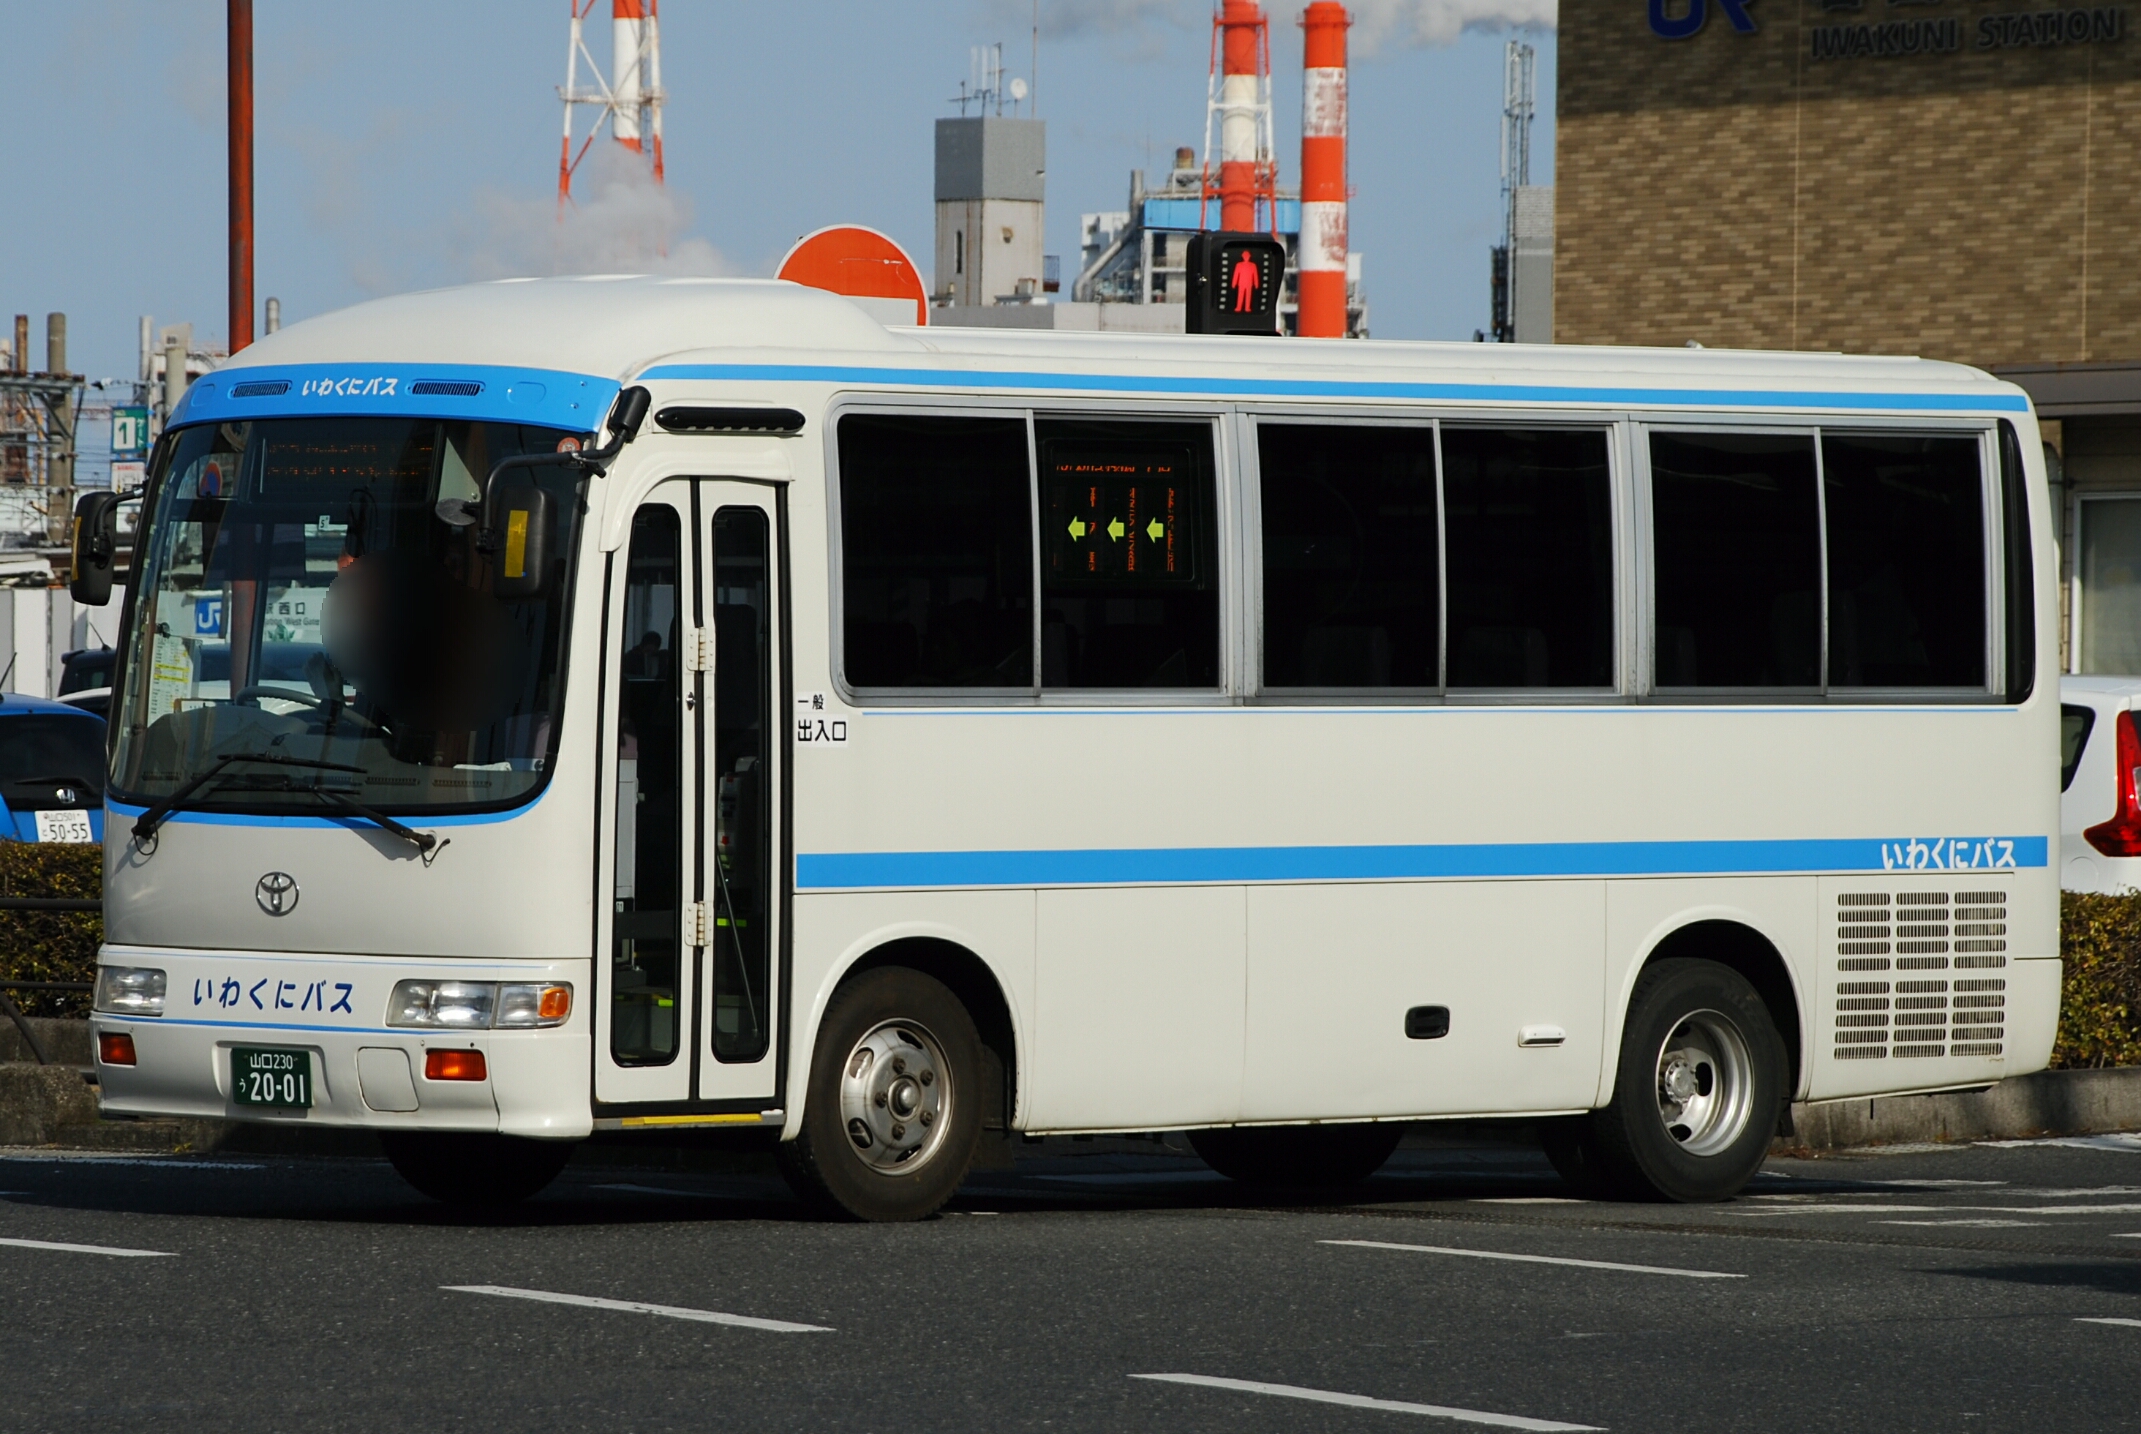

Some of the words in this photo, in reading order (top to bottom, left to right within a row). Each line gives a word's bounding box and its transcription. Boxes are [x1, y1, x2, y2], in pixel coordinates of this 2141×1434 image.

[1811, 18, 1957, 57] IWAKUNI
[1977, 7, 2118, 47] STATION
[301, 376, 399, 396] いわくにバス
[118, 421, 127, 445] 1
[797, 693, 824, 710] 一般
[797, 719, 847, 742] 出入口
[1881, 837, 2017, 871] いわくにバス
[193, 975, 354, 1015] いわくにバス
[249, 1071, 305, 1104] 20-01
